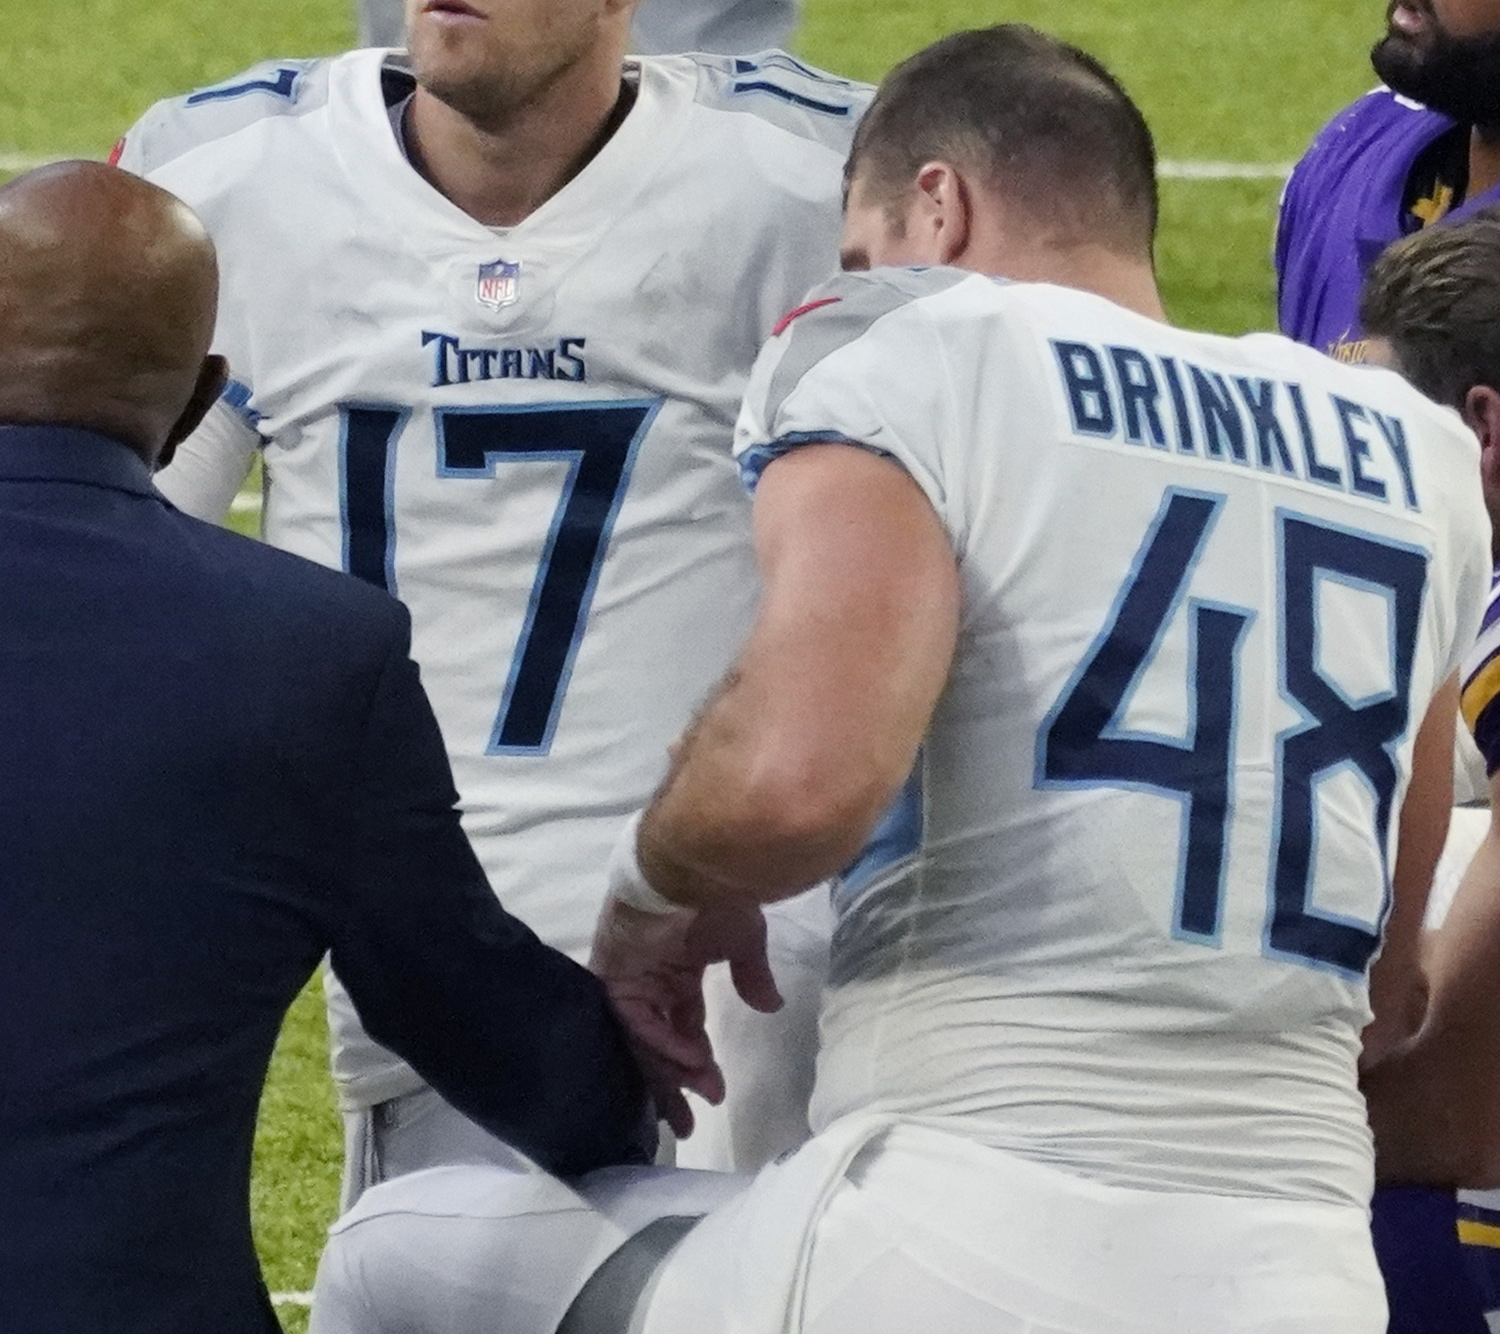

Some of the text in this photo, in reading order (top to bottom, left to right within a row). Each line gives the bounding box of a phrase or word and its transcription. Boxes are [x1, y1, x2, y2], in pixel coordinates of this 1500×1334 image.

[421, 330, 586, 387] TITANS
[481, 278, 514, 300] NFL
[1047, 335, 1424, 514] BRINKLEY
[337, 397, 668, 758] 17
[1033, 486, 1434, 978] 48
